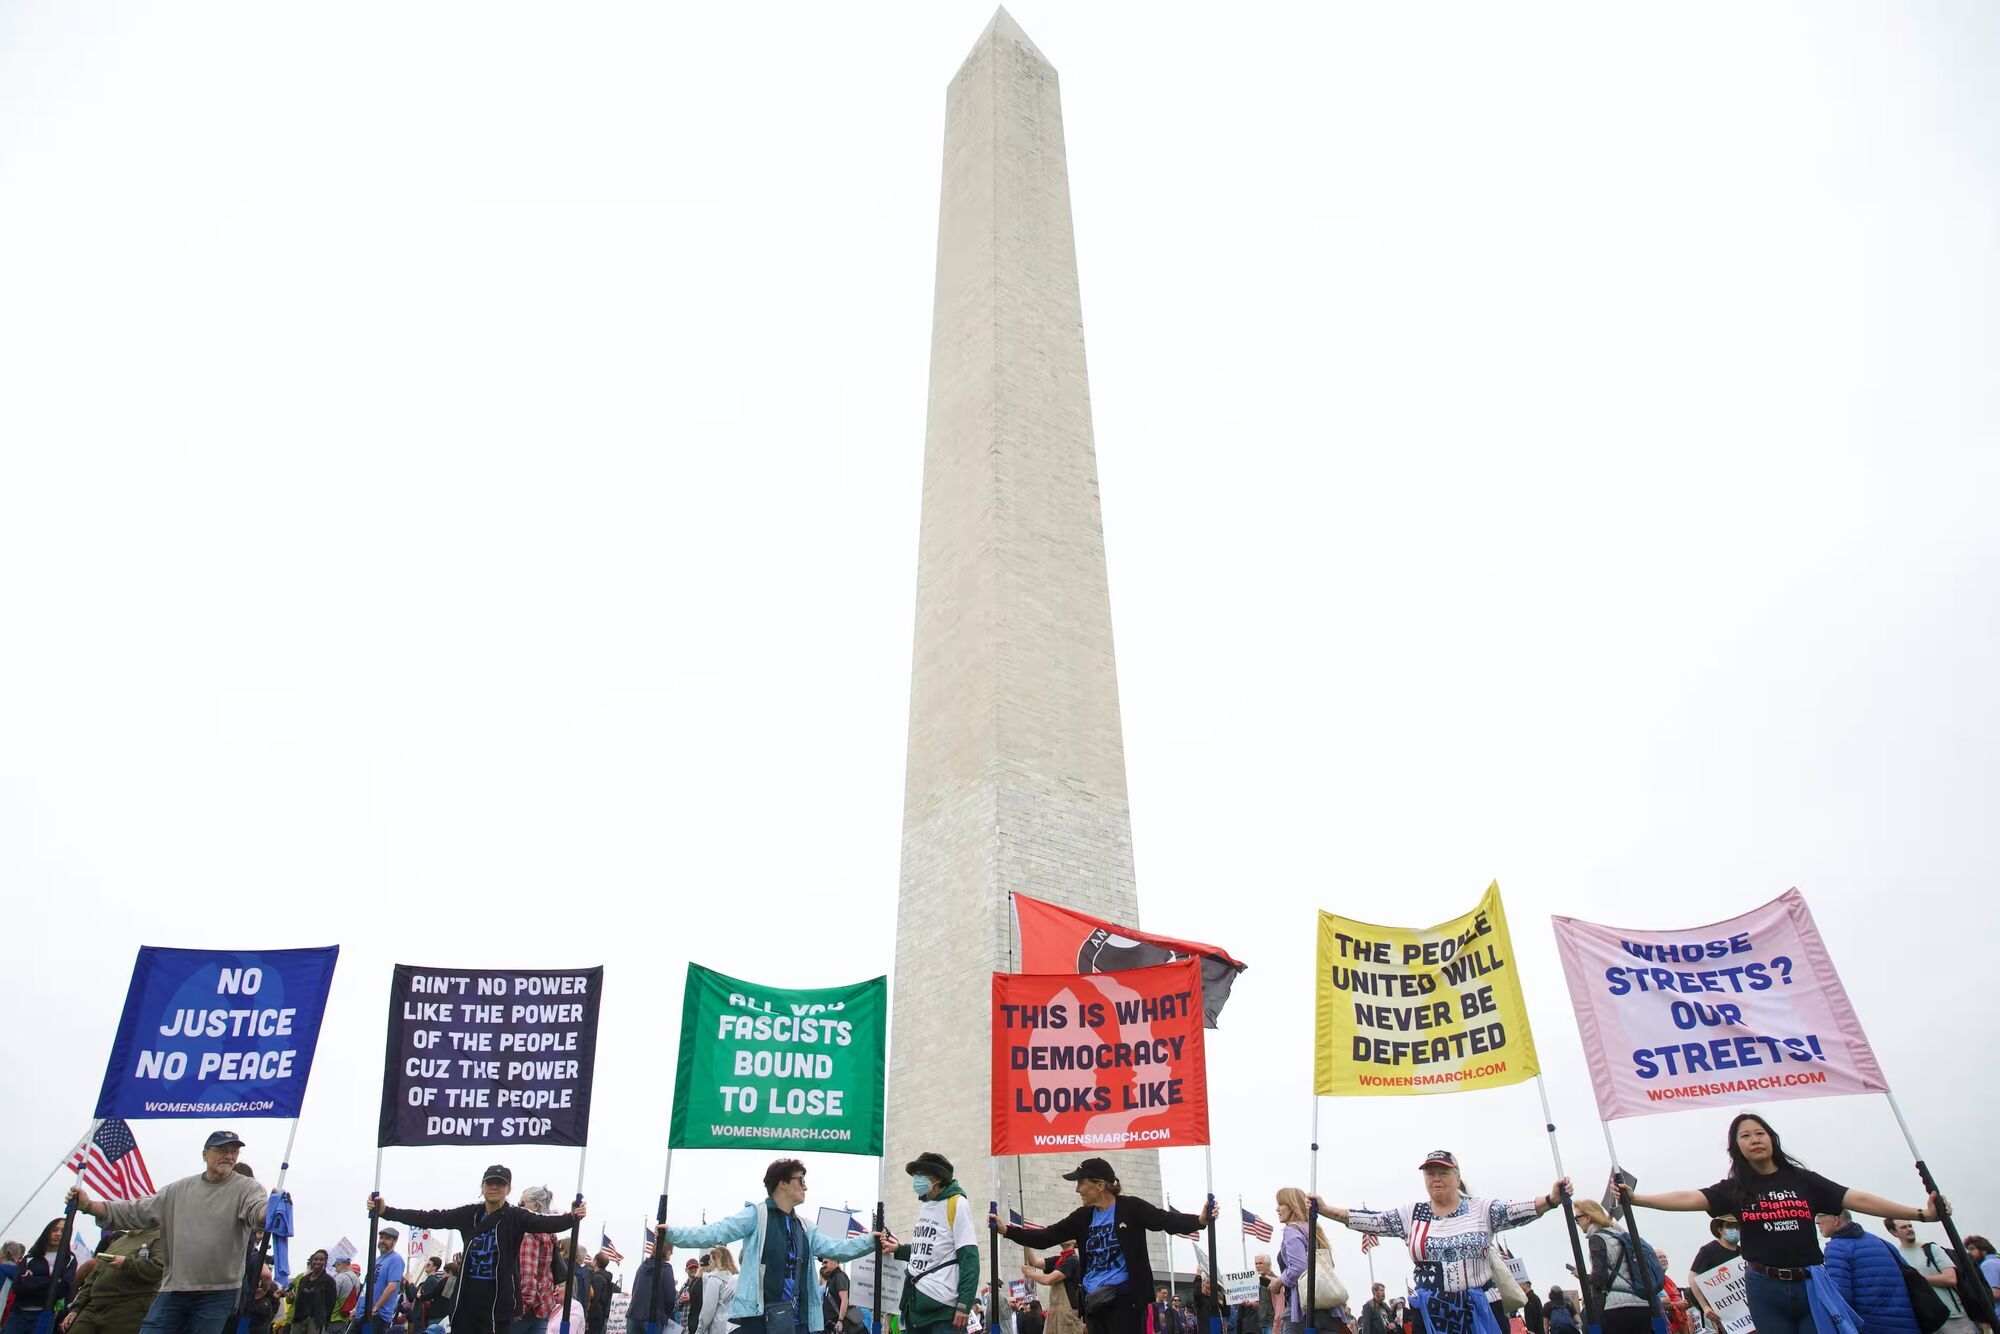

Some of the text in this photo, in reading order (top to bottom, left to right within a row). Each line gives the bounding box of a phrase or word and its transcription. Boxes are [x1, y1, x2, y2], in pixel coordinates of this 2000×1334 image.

[1334, 932, 1391, 965] THE
[1620, 931, 1753, 964] WHOSE
[217, 967, 262, 995] NO
[412, 975, 587, 995] AIN'T NO POWER
[1332, 944, 1504, 998] UNITED WILL
[1605, 956, 1793, 996] STREETS?
[403, 1001, 583, 1023] LIKE THE POWER
[728, 993, 780, 1015] ALL
[1000, 991, 1192, 1029] THIS IS WHAT
[1354, 985, 1497, 1032] NEVER BE
[1671, 1001, 1749, 1030] OUR
[160, 1008, 296, 1037] JUSTICE
[718, 1014, 852, 1046] FASCISTS
[413, 1030, 578, 1052] OF THE PEOPLE
[1011, 1035, 1186, 1071] DEMOCRACY
[1353, 1022, 1506, 1066] DEFEATED
[135, 1050, 296, 1080] NO PEACE
[405, 1058, 578, 1080] CUZ THE POWER
[734, 1050, 833, 1079] BOUND
[1633, 1034, 1827, 1079] STREETS!
[1359, 1061, 1507, 1087] WOMENSMARCH.COM
[1647, 1071, 1827, 1101] WOMENSMARCH.COM
[145, 1101, 274, 1113] WOMENSMARCH.COM
[408, 1087, 572, 1109] OF THE PEOPLE
[719, 1086, 844, 1116] TO LOSE
[1016, 1078, 1184, 1113] LOOKS LIKE
[427, 1116, 552, 1137] DON'T STOP
[711, 1124, 851, 1140] WOMENSMARCH.COM
[1034, 1128, 1170, 1146] WOMENSMARCH.COM
[1760, 1199, 1809, 1210] Planned
[1768, 1190, 1798, 1201] fight
[1742, 1208, 1812, 1221] Parenthood
[1226, 1270, 1255, 1281] TRUMP
[1704, 1271, 1731, 1288] NERO
